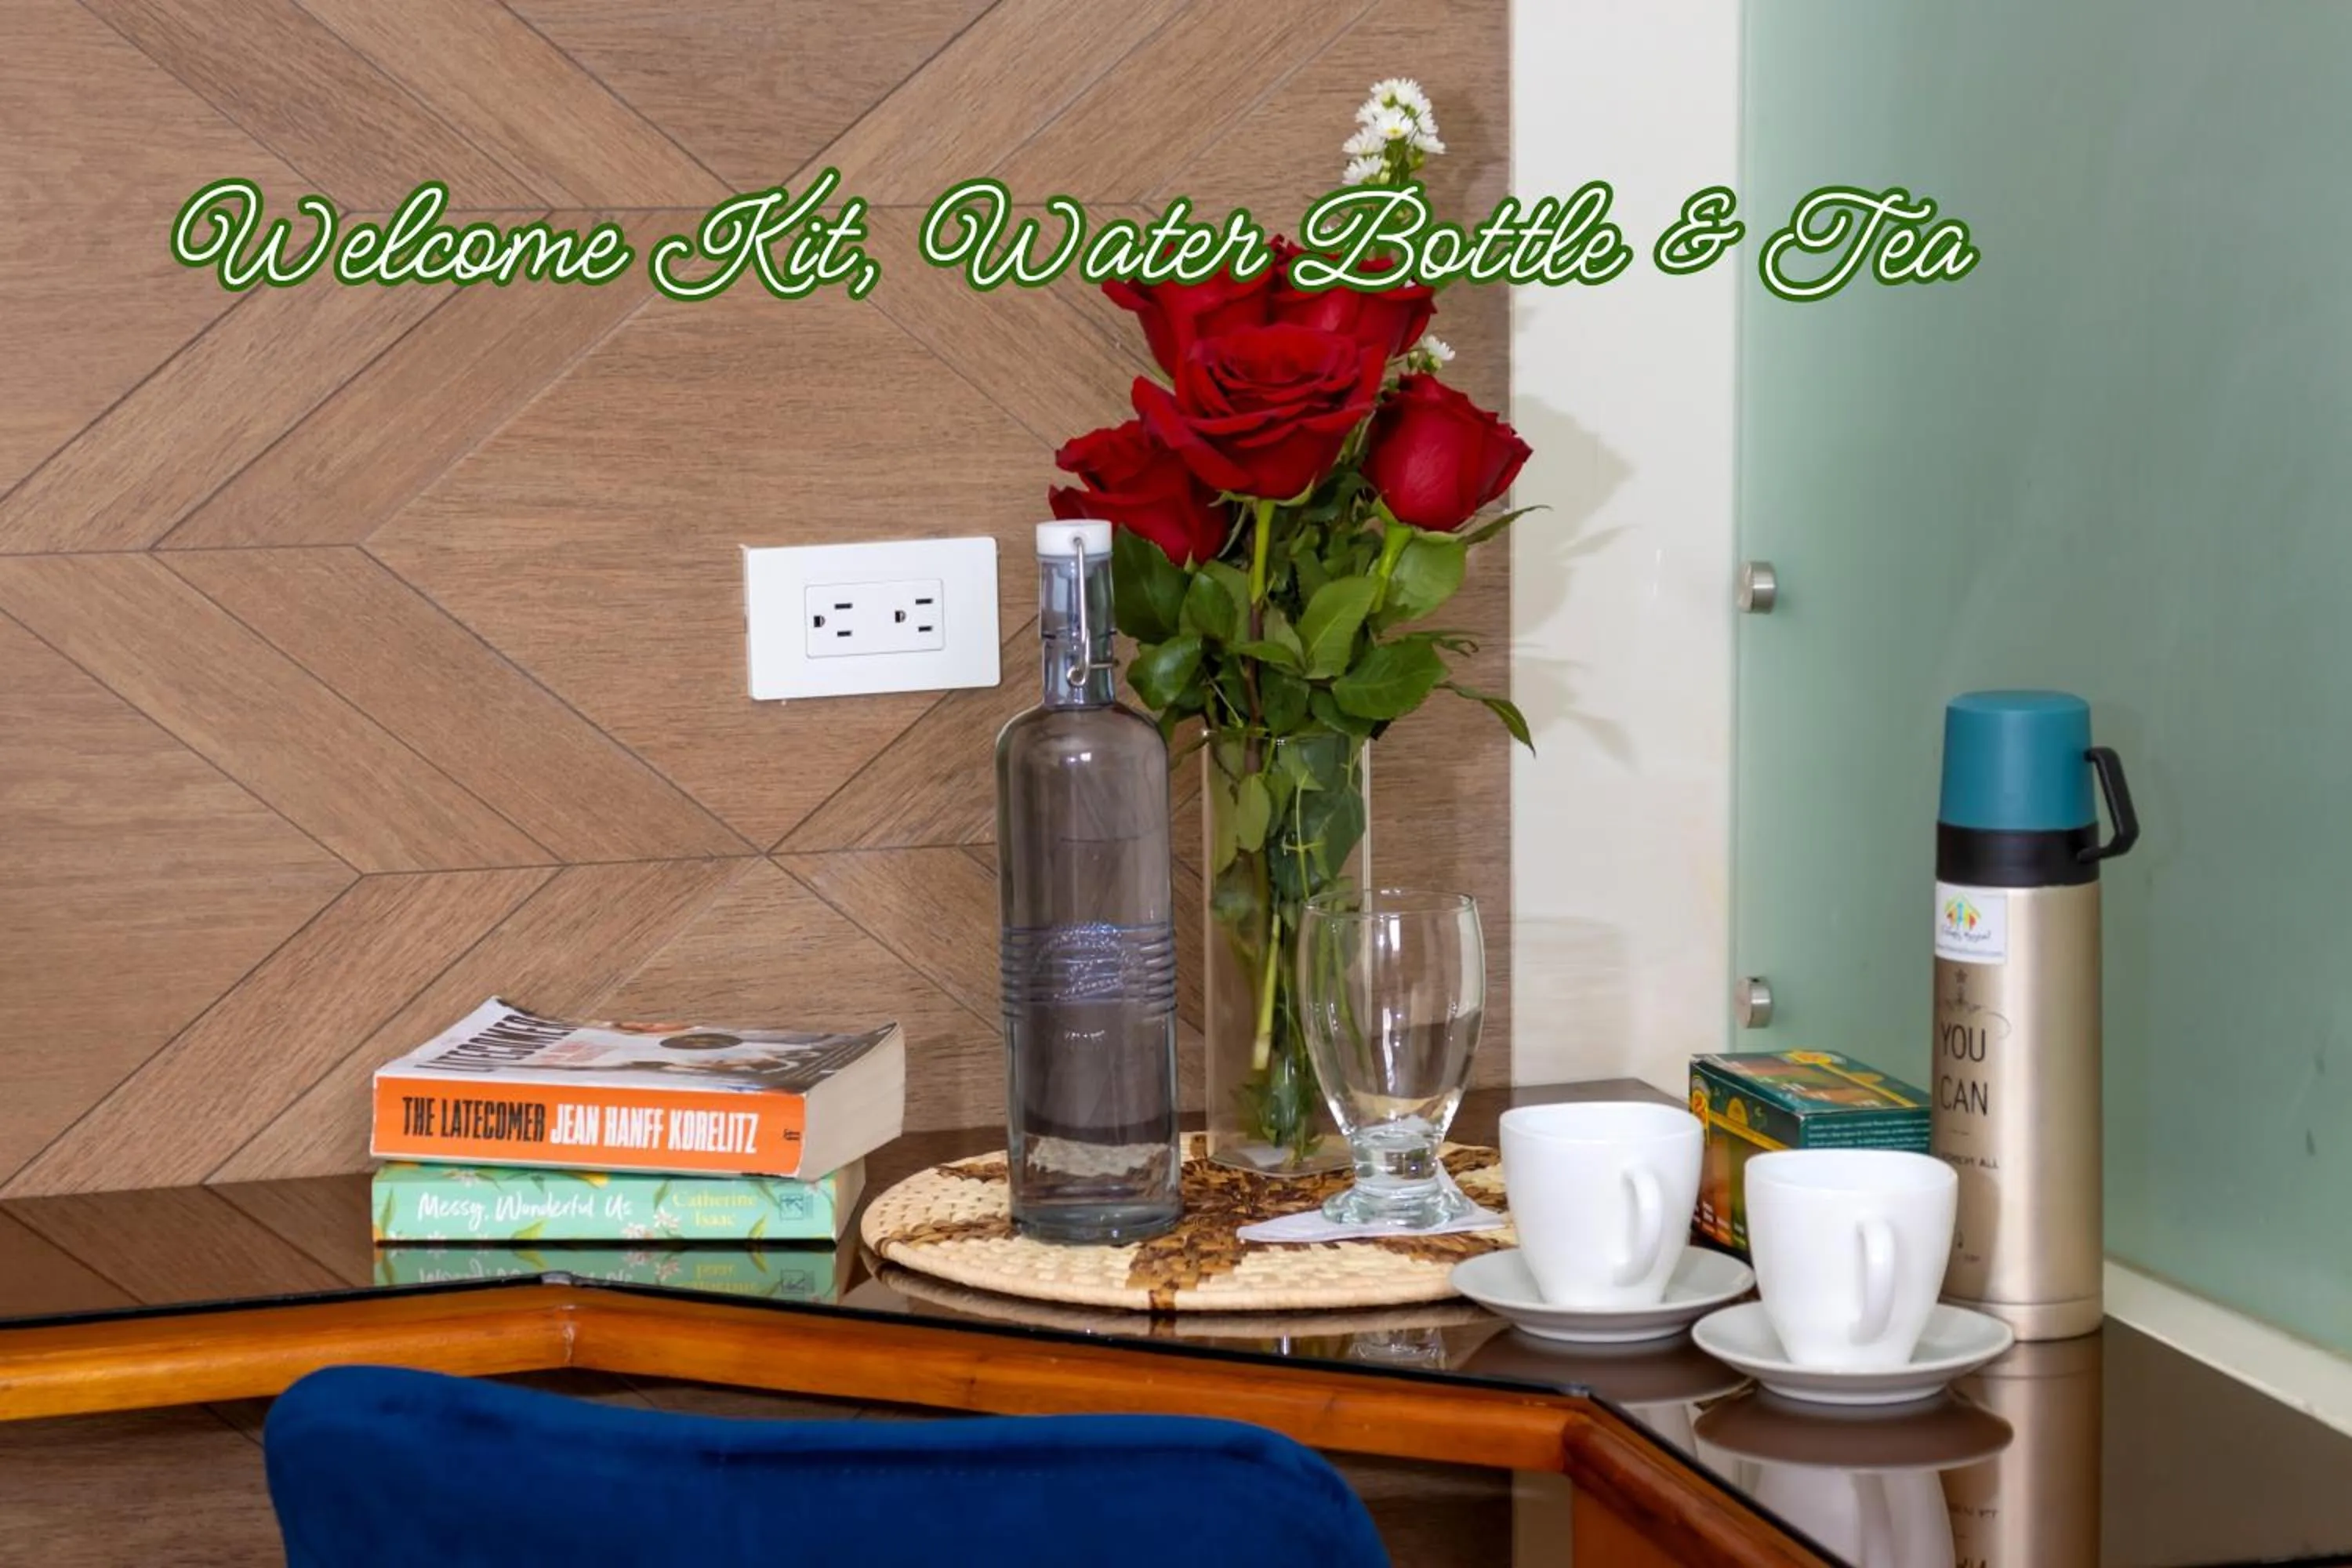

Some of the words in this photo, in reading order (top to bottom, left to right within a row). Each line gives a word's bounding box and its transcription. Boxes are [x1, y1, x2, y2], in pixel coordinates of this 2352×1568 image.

[1940, 1022, 1986, 1062] YOU
[1940, 1075, 1987, 1116] CAN
[402, 1096, 435, 1136] THE
[440, 1099, 546, 1142] LATECOMER
[550, 1103, 599, 1146] JEAN
[603, 1106, 664, 1150] HANFF
[667, 1109, 759, 1153] KORELITZ
[495, 1190, 593, 1221] Wonderful
[604, 1193, 633, 1220] Us
[672, 1189, 757, 1208] Catherine
[695, 1210, 735, 1226] Isaac
